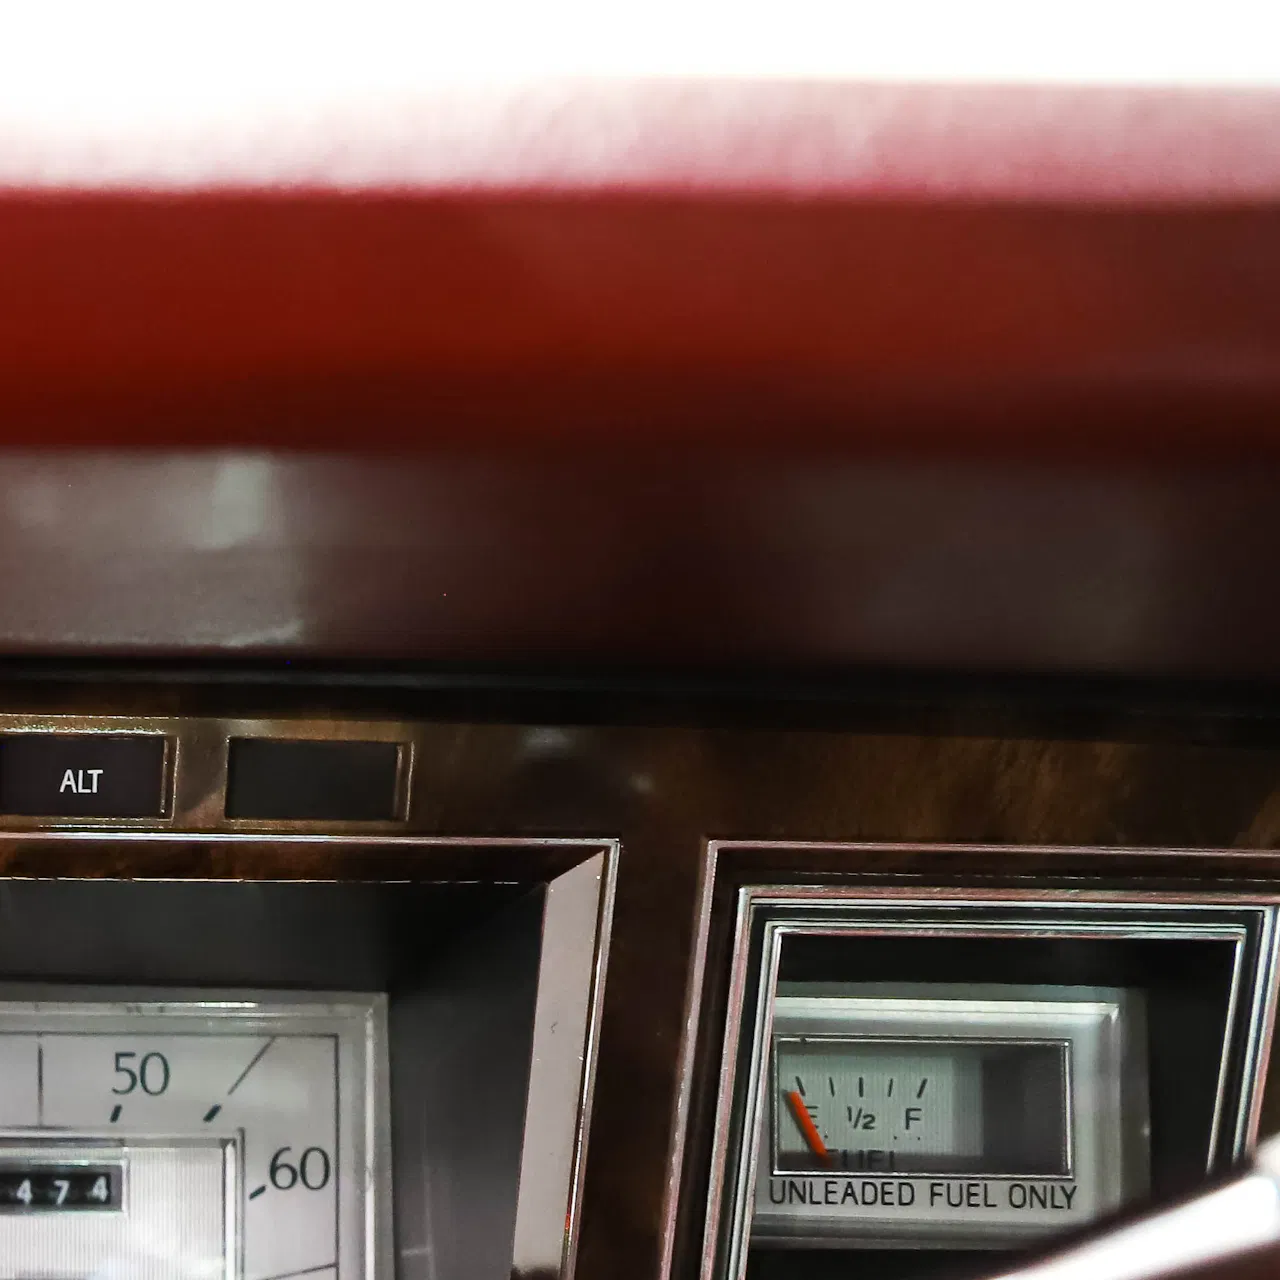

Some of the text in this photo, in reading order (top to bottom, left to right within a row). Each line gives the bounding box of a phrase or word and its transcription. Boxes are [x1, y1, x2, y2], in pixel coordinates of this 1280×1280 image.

[59, 769, 104, 795] ALT
[110, 1051, 171, 1097] 50
[904, 1107, 922, 1130] F
[268, 1145, 332, 1191] 60
[769, 1179, 1079, 1210] UNLEADED FUEL ONLY
